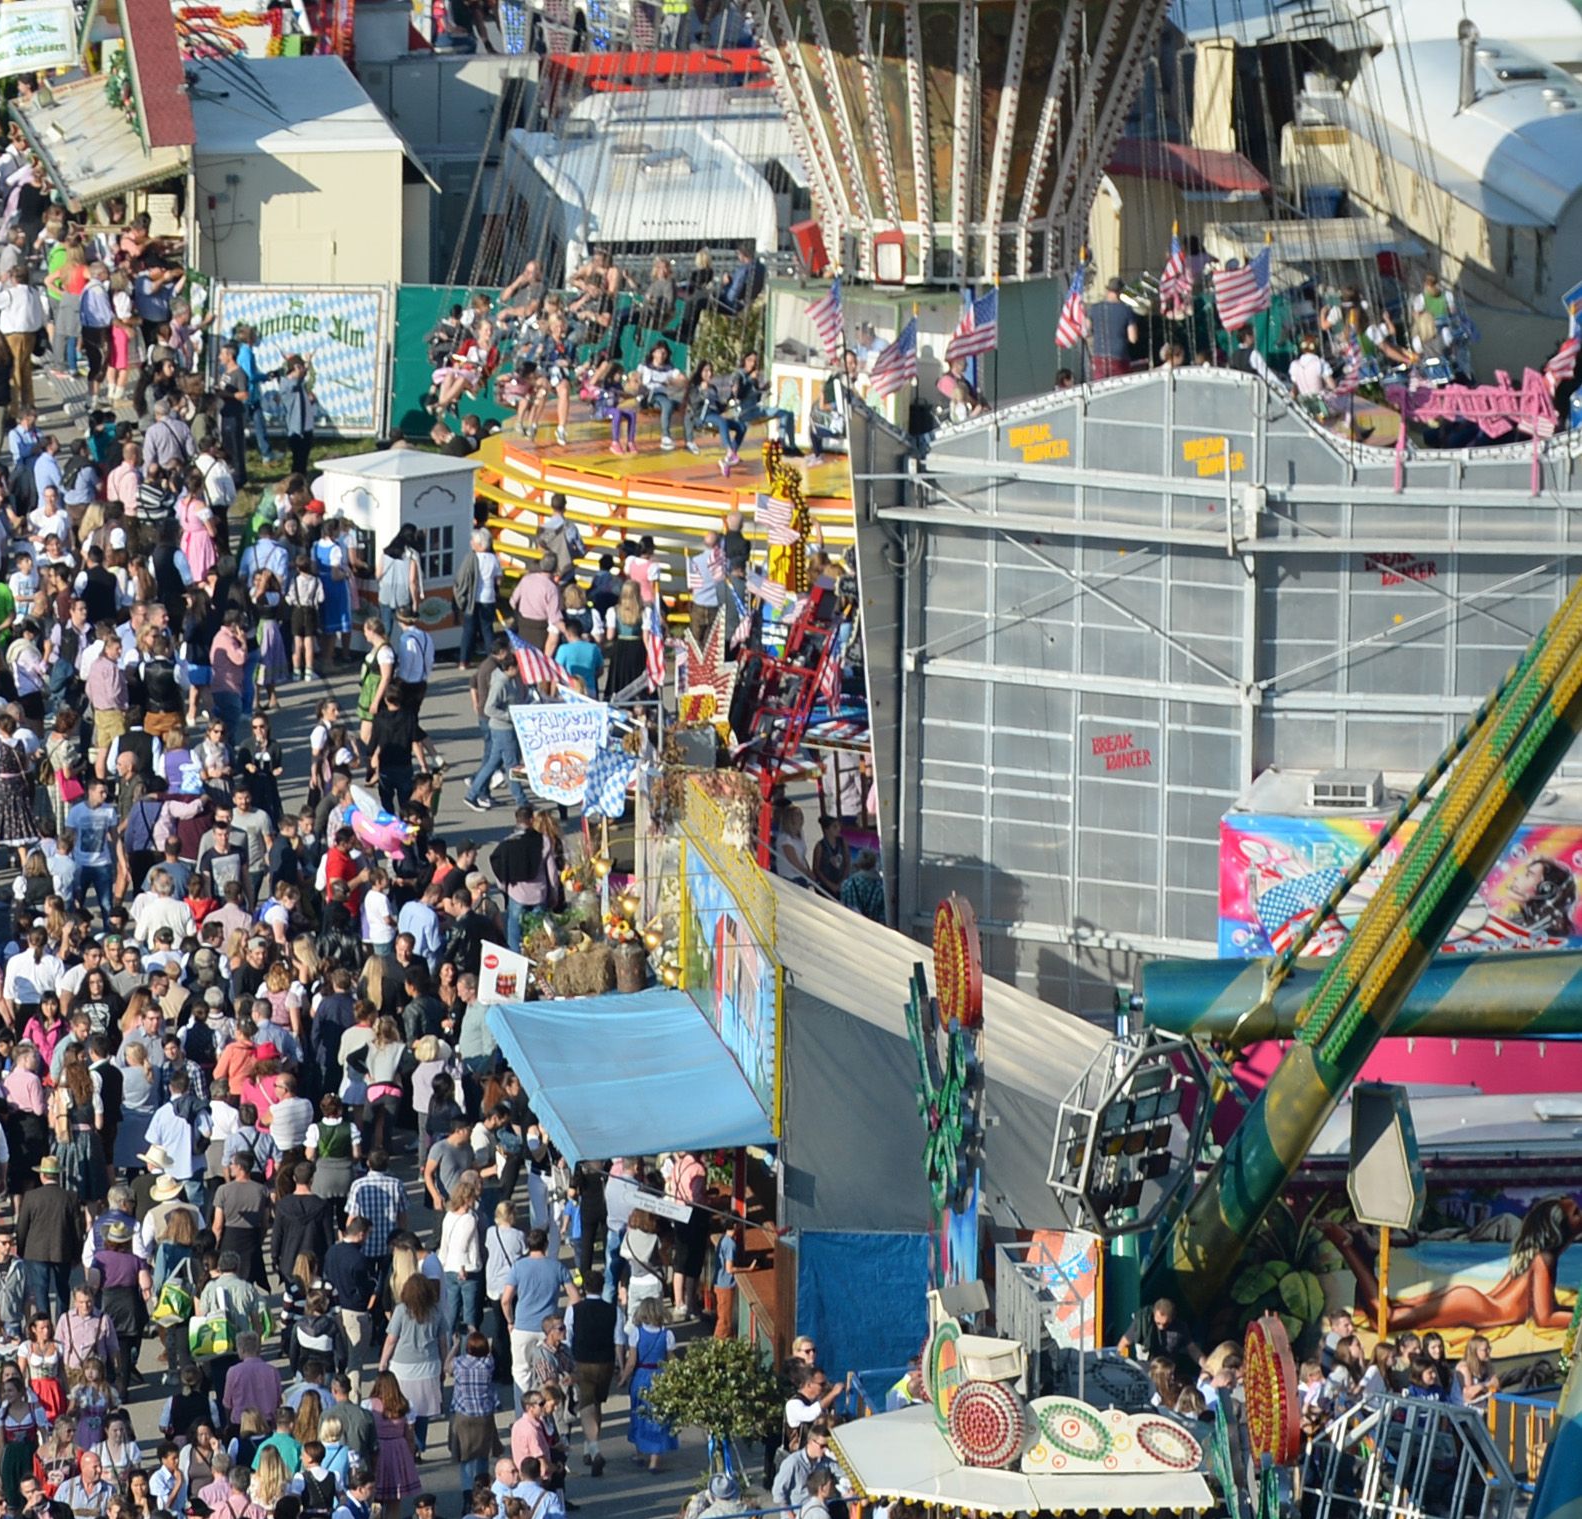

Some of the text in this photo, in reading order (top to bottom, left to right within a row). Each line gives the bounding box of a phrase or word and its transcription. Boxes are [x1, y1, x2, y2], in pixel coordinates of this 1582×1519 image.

[1197, 452, 1246, 477] DANCR
[1092, 734, 1133, 755] BREAK
[1106, 749, 1151, 770] DANCER
